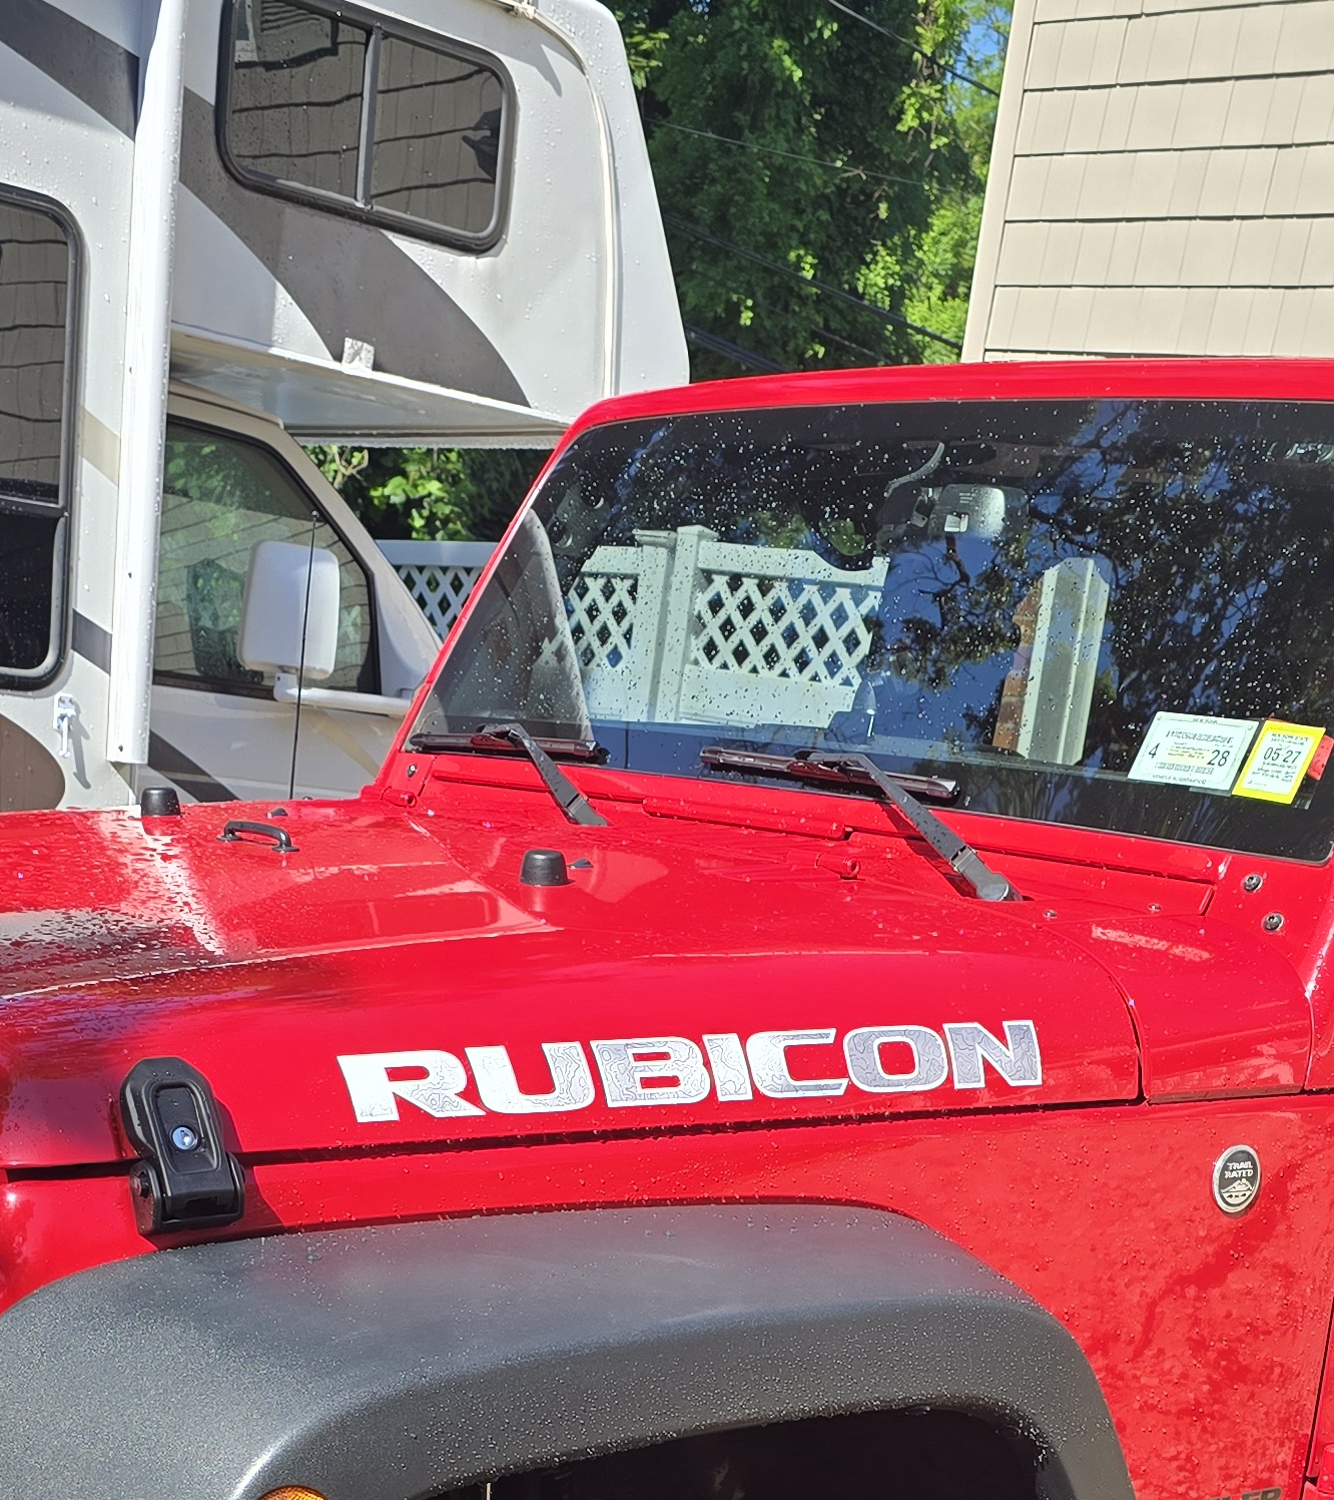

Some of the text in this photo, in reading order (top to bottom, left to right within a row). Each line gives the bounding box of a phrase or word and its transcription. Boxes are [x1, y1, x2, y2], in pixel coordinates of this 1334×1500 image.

[1148, 742, 1161, 759] 4
[1207, 749, 1231, 767] 28
[336, 1019, 1044, 1123] RUBICON
[1224, 1169, 1254, 1179] RATED
[1227, 1161, 1254, 1170] TRAIL
